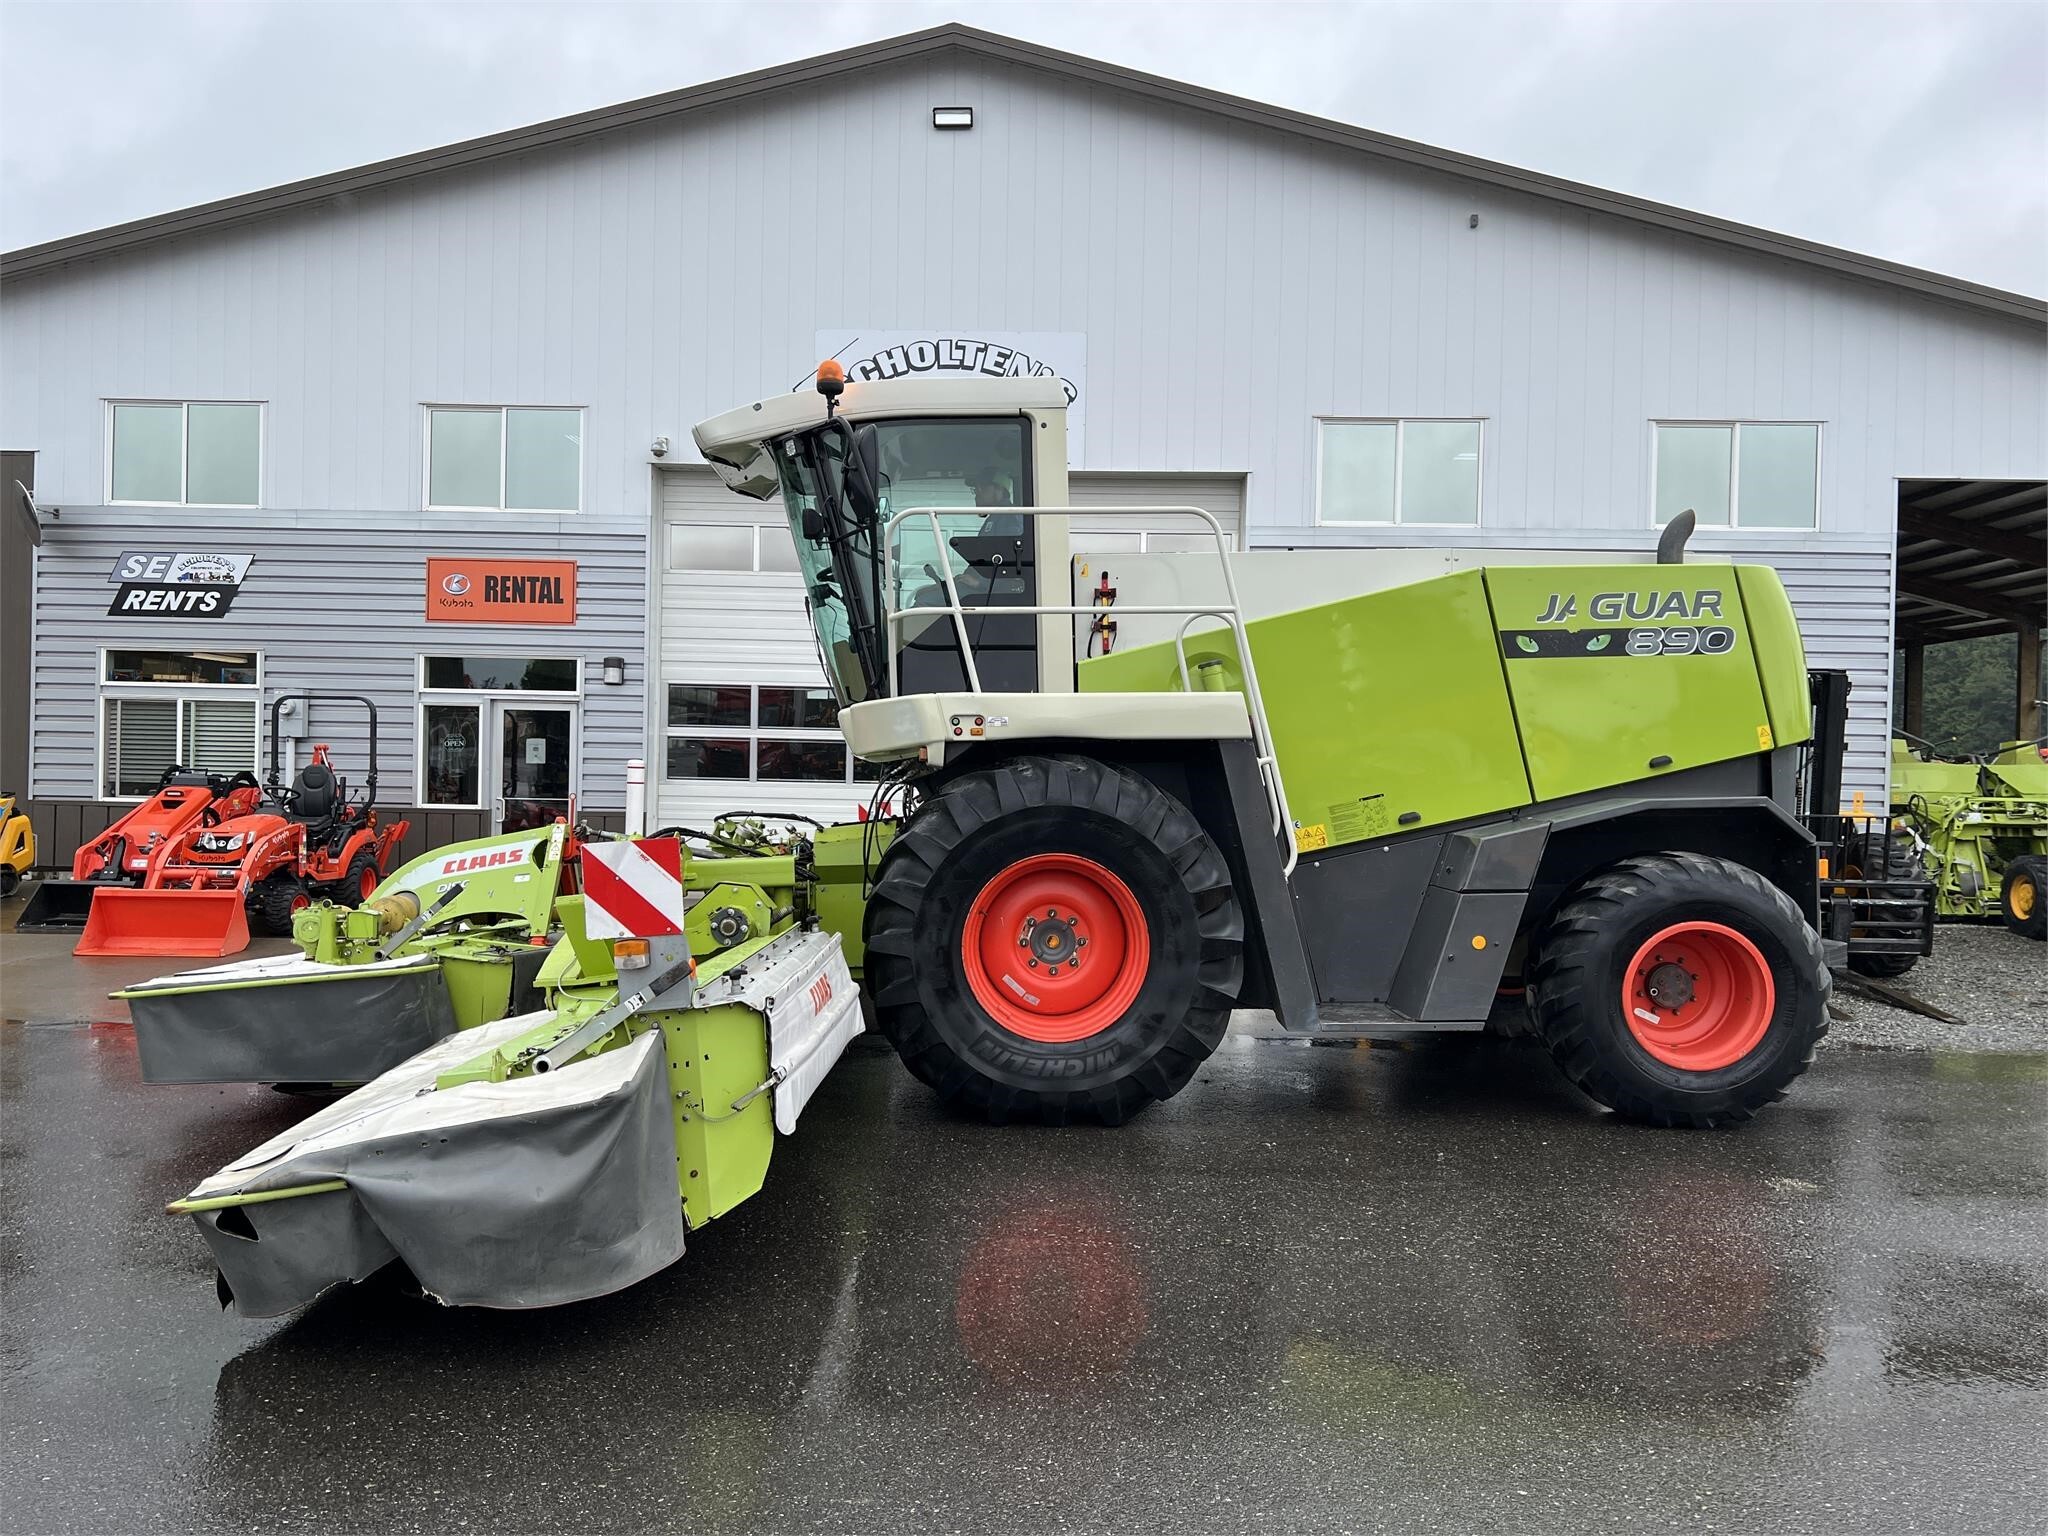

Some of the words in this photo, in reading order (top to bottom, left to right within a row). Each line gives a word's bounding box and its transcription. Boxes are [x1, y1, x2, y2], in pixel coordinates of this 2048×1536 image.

[843, 339, 1078, 406] CHOLTEN'
[120, 555, 171, 579] SE
[121, 589, 222, 612] RENTS
[439, 598, 474, 608] Kubota
[484, 575, 564, 604] RENTAL
[1625, 625, 1736, 657] 890
[442, 849, 524, 875] CLAAS
[976, 1039, 1121, 1078] MICHELIN
